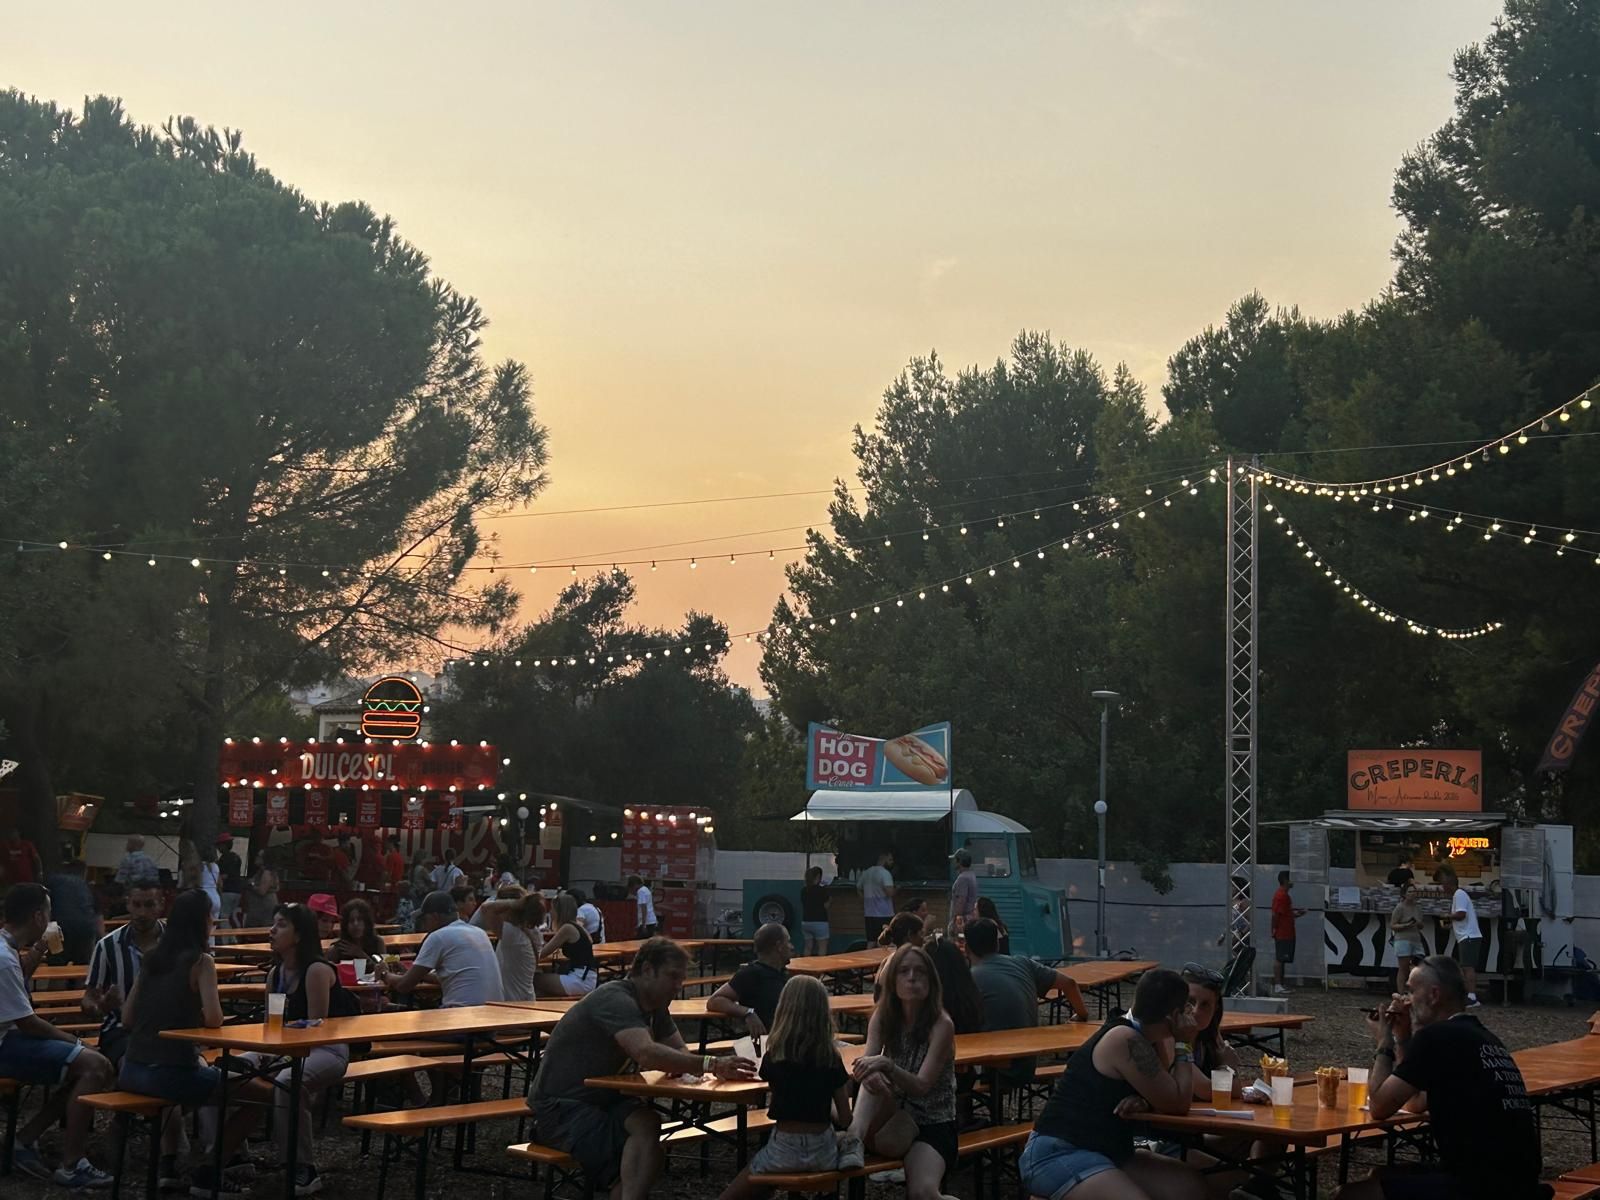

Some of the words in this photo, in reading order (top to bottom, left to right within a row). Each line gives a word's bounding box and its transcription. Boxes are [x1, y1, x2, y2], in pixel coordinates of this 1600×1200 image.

[1550, 662, 1600, 760] CREP
[820, 737, 870, 759] HOT
[818, 758, 868, 778] DOG
[1350, 758, 1480, 796] CREPERIA
